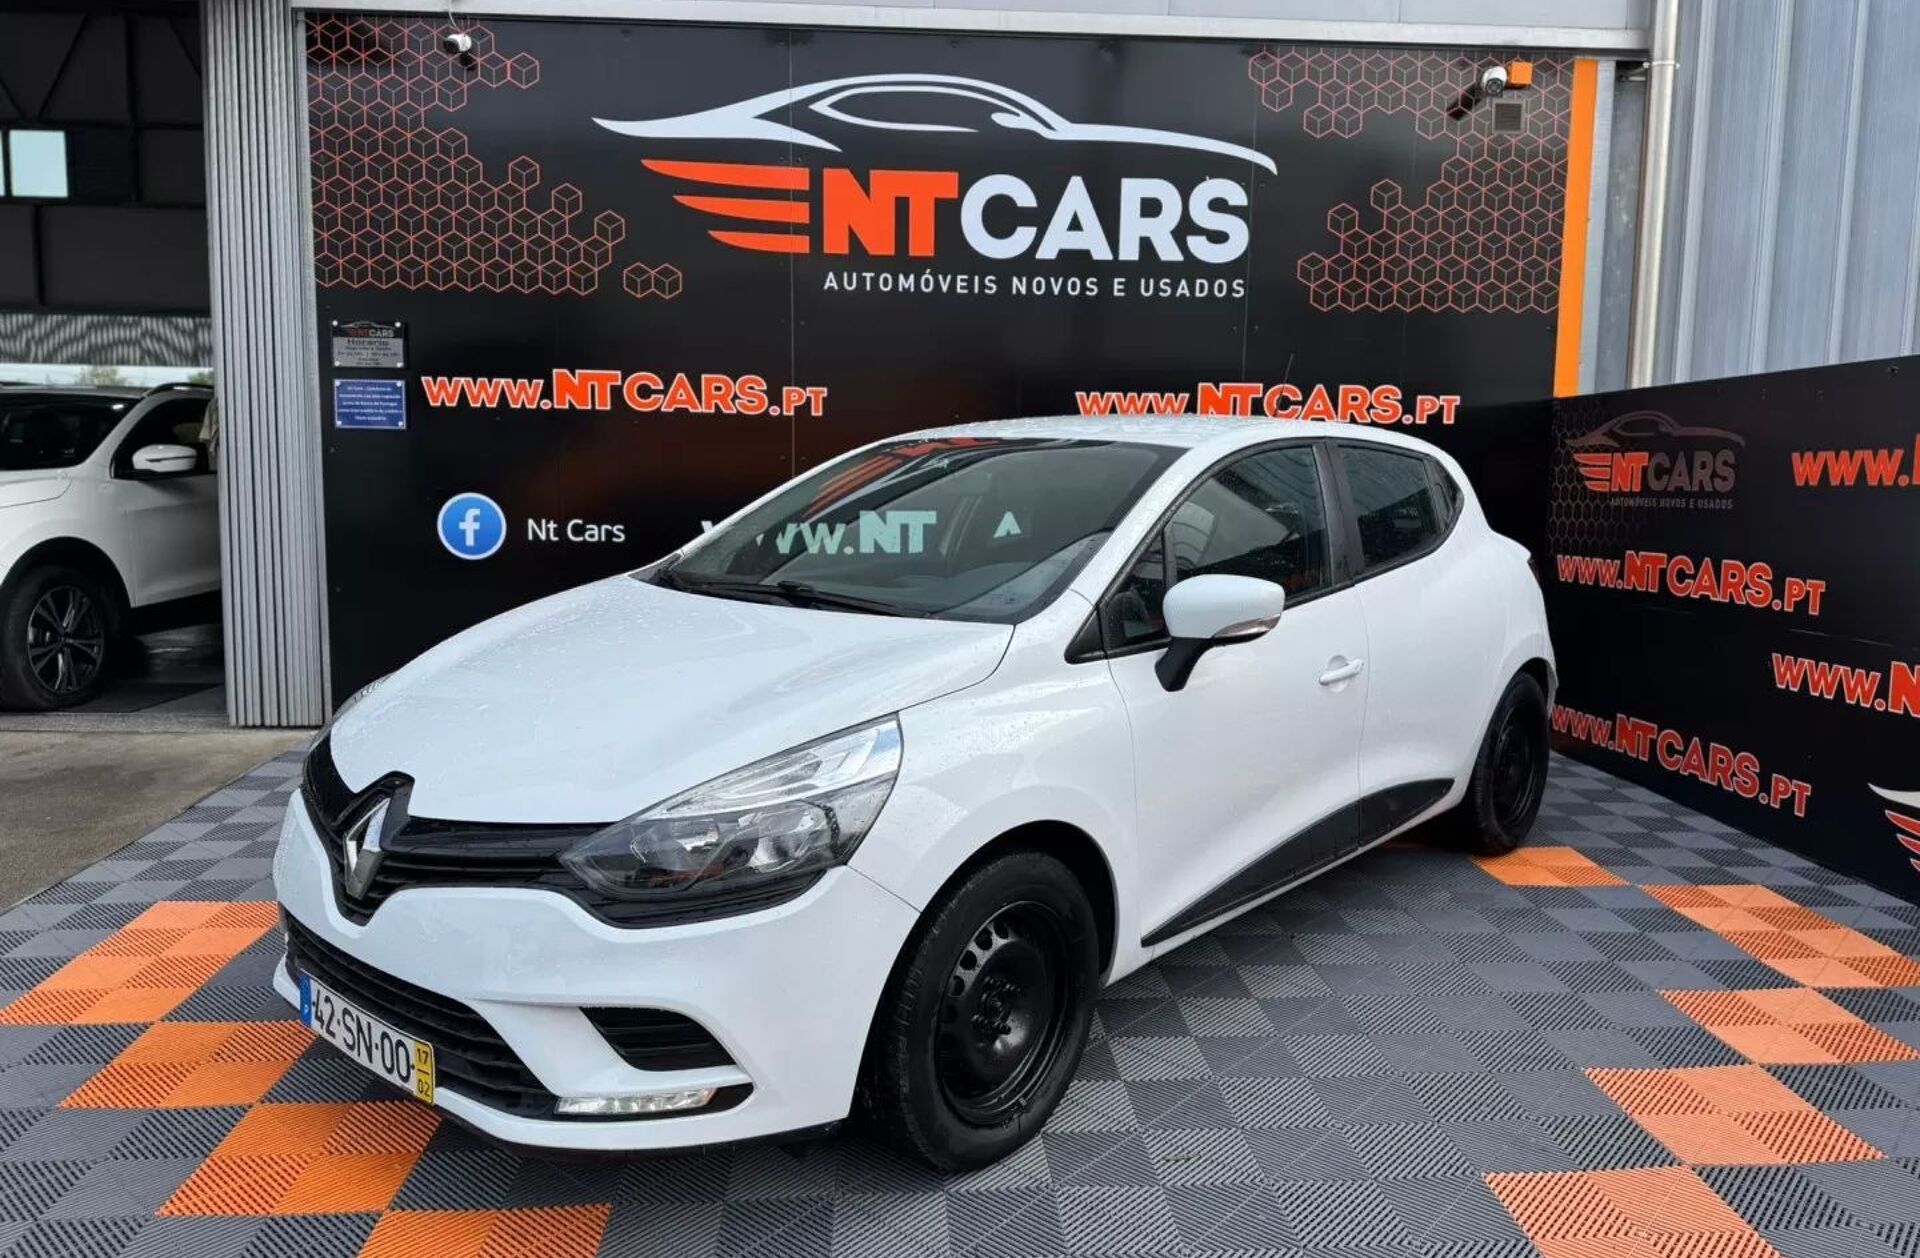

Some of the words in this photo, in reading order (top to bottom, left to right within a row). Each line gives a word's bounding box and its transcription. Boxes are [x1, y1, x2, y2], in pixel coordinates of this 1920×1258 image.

[823, 268, 998, 295] AUTOMÓVEIS
[1011, 276, 1099, 297] NOVOS
[1113, 278, 1126, 297] E
[1140, 278, 1246, 299] USADOS
[527, 518, 559, 542] Nt
[566, 518, 626, 543] Cars
[416, 1047, 429, 1065] 17
[417, 1078, 430, 1098] 02
